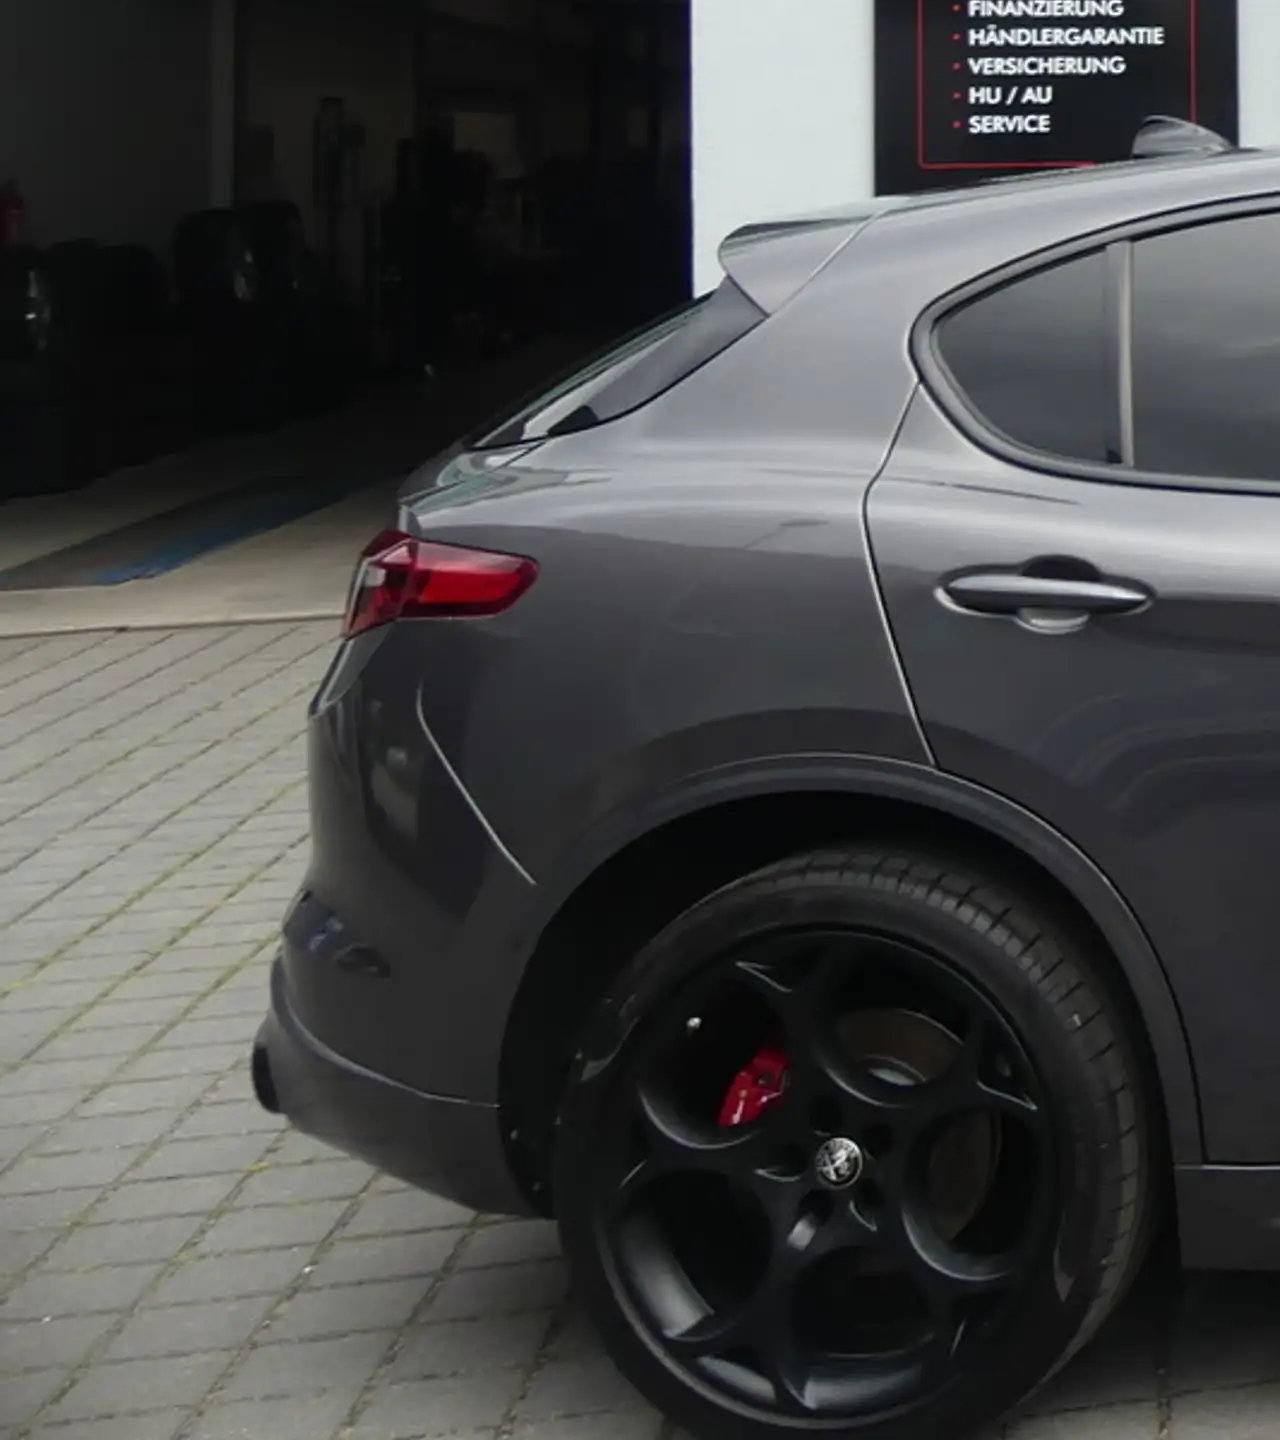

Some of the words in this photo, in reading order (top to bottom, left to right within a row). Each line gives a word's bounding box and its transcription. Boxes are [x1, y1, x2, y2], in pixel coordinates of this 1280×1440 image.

[968, 24, 1165, 46] HÄNDLERGARANTIE
[968, 56, 1127, 76] VERSICHERUNG
[968, 86, 1002, 105] HU
[1021, 86, 1053, 104] AU
[968, 114, 1051, 134] SERVICE
